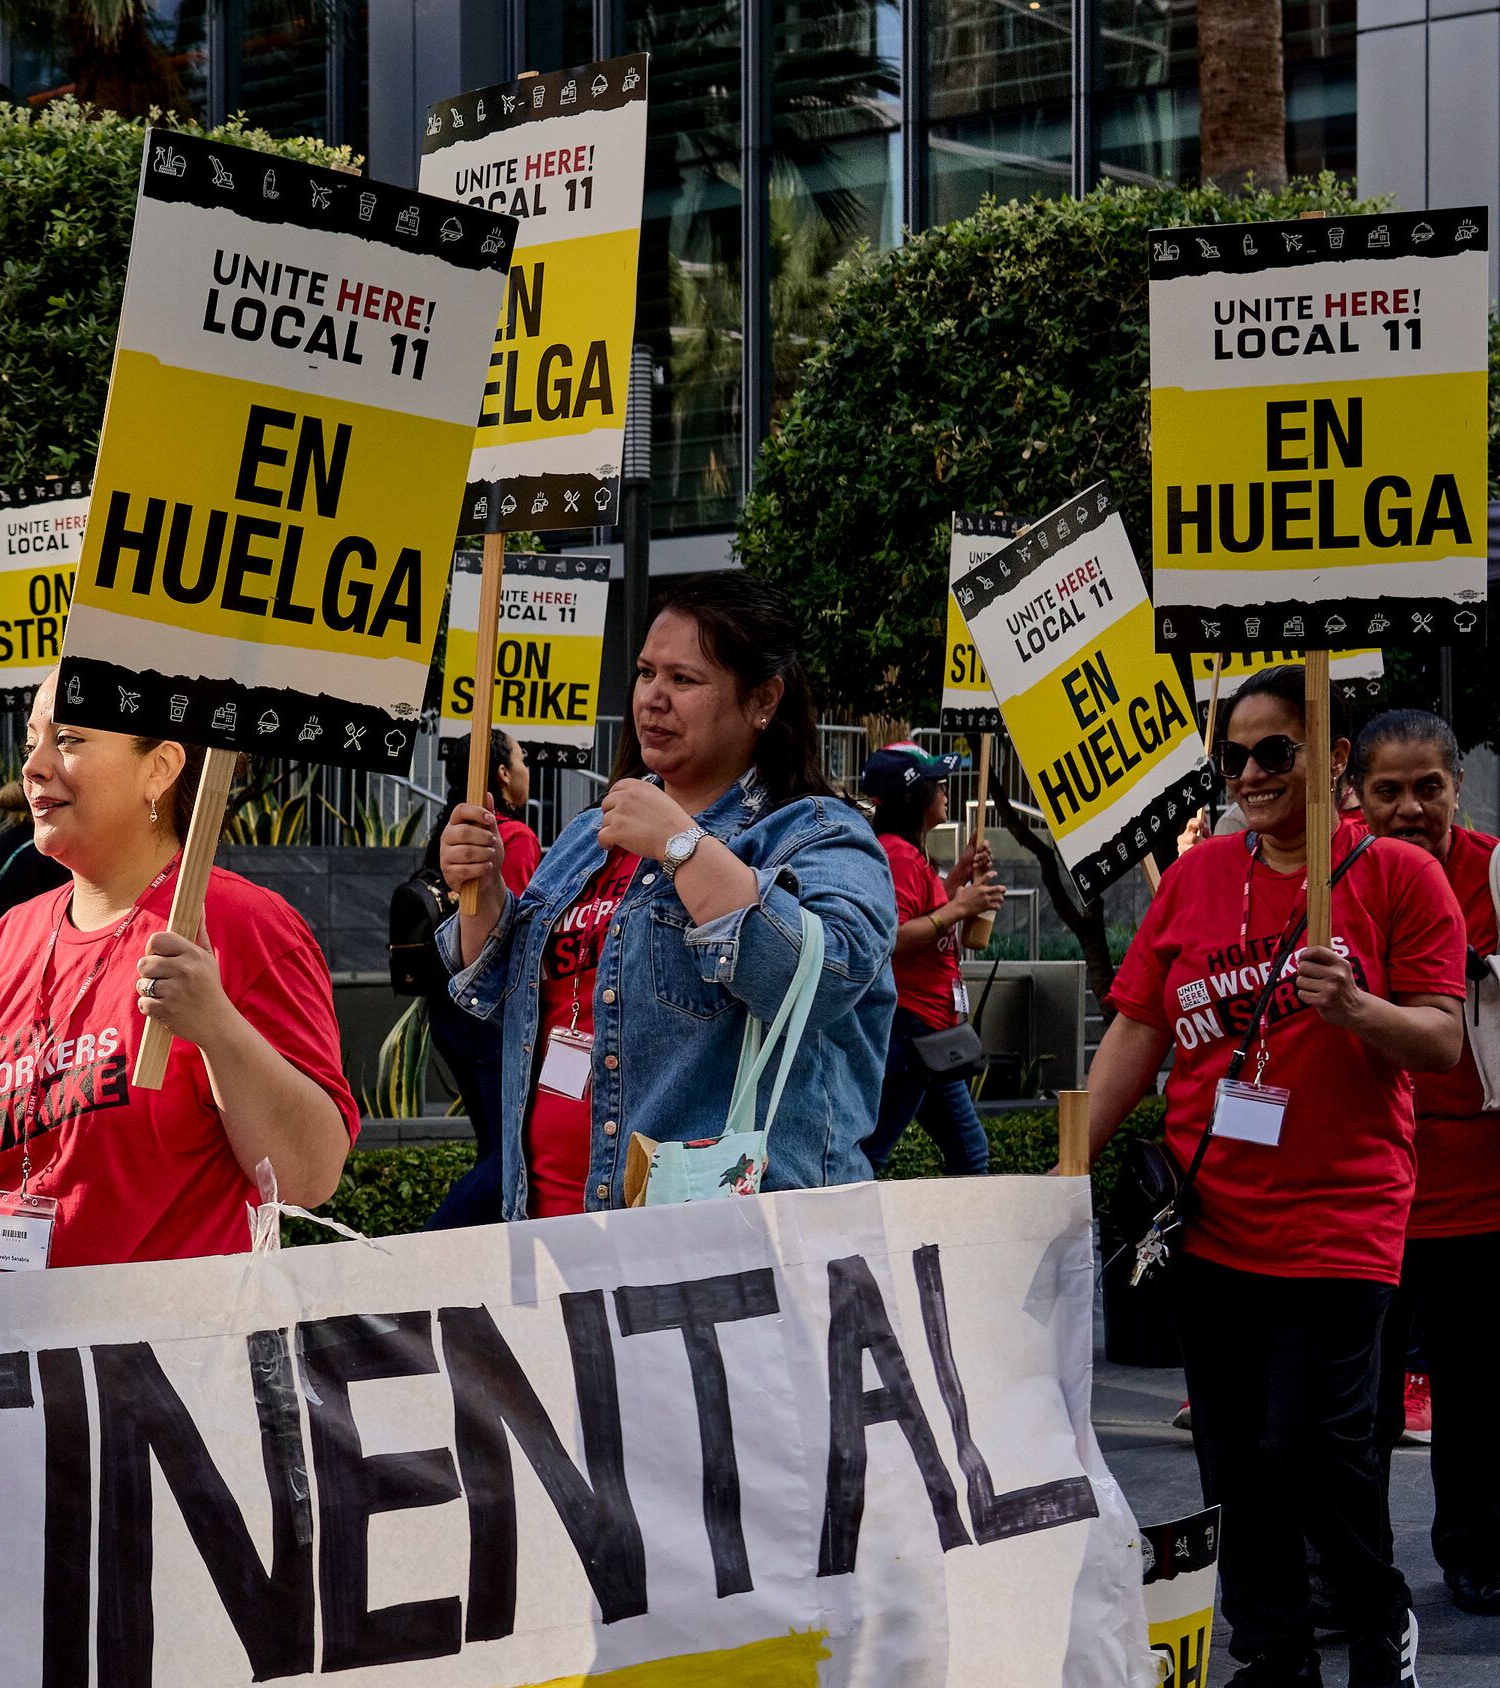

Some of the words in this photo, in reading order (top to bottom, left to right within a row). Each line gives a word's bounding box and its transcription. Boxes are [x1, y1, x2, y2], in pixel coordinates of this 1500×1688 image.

[455, 158, 518, 196] UNITE
[525, 145, 595, 181] HERE!
[456, 183, 547, 219] CAL
[564, 176, 594, 212] 11
[212, 249, 329, 302] UNITE
[336, 279, 436, 334] HERE!
[493, 261, 545, 342] N
[1213, 295, 1314, 326] UNITE
[1324, 288, 1423, 319] HERE!
[202, 288, 364, 366] LOCAL
[389, 333, 431, 381] 11
[1213, 321, 1360, 361] LOCAL
[1382, 318, 1424, 352] 11
[477, 339, 614, 428] ELGA
[1265, 396, 1364, 471] EN
[234, 404, 353, 518] EN
[7, 519, 50, 536] UNITE
[54, 515, 87, 531] HERE
[1166, 473, 1473, 555] HUELGA
[8, 533, 69, 555] LOCAL
[94, 490, 423, 645] HUELGA
[969, 551, 994, 564] UNI
[29, 572, 75, 616] ON
[499, 604, 547, 621] CAL
[558, 607, 577, 623] 11
[500, 590, 529, 603] ITE
[532, 591, 578, 606] HERE!
[1006, 588, 1057, 636] UNITE
[1055, 556, 1103, 601] HERE!
[1014, 599, 1086, 663] LOCAL
[1089, 577, 1114, 608] 11
[497, 640, 551, 680] ON
[1061, 650, 1120, 731] EN
[1037, 680, 1188, 825] HUELGA
[1207, 931, 1283, 973] HOTE
[1209, 935, 1350, 998] WORKS
[1178, 981, 1204, 996] UNITE
[1180, 988, 1206, 1004] HERE!
[1175, 1007, 1225, 1050] ON
